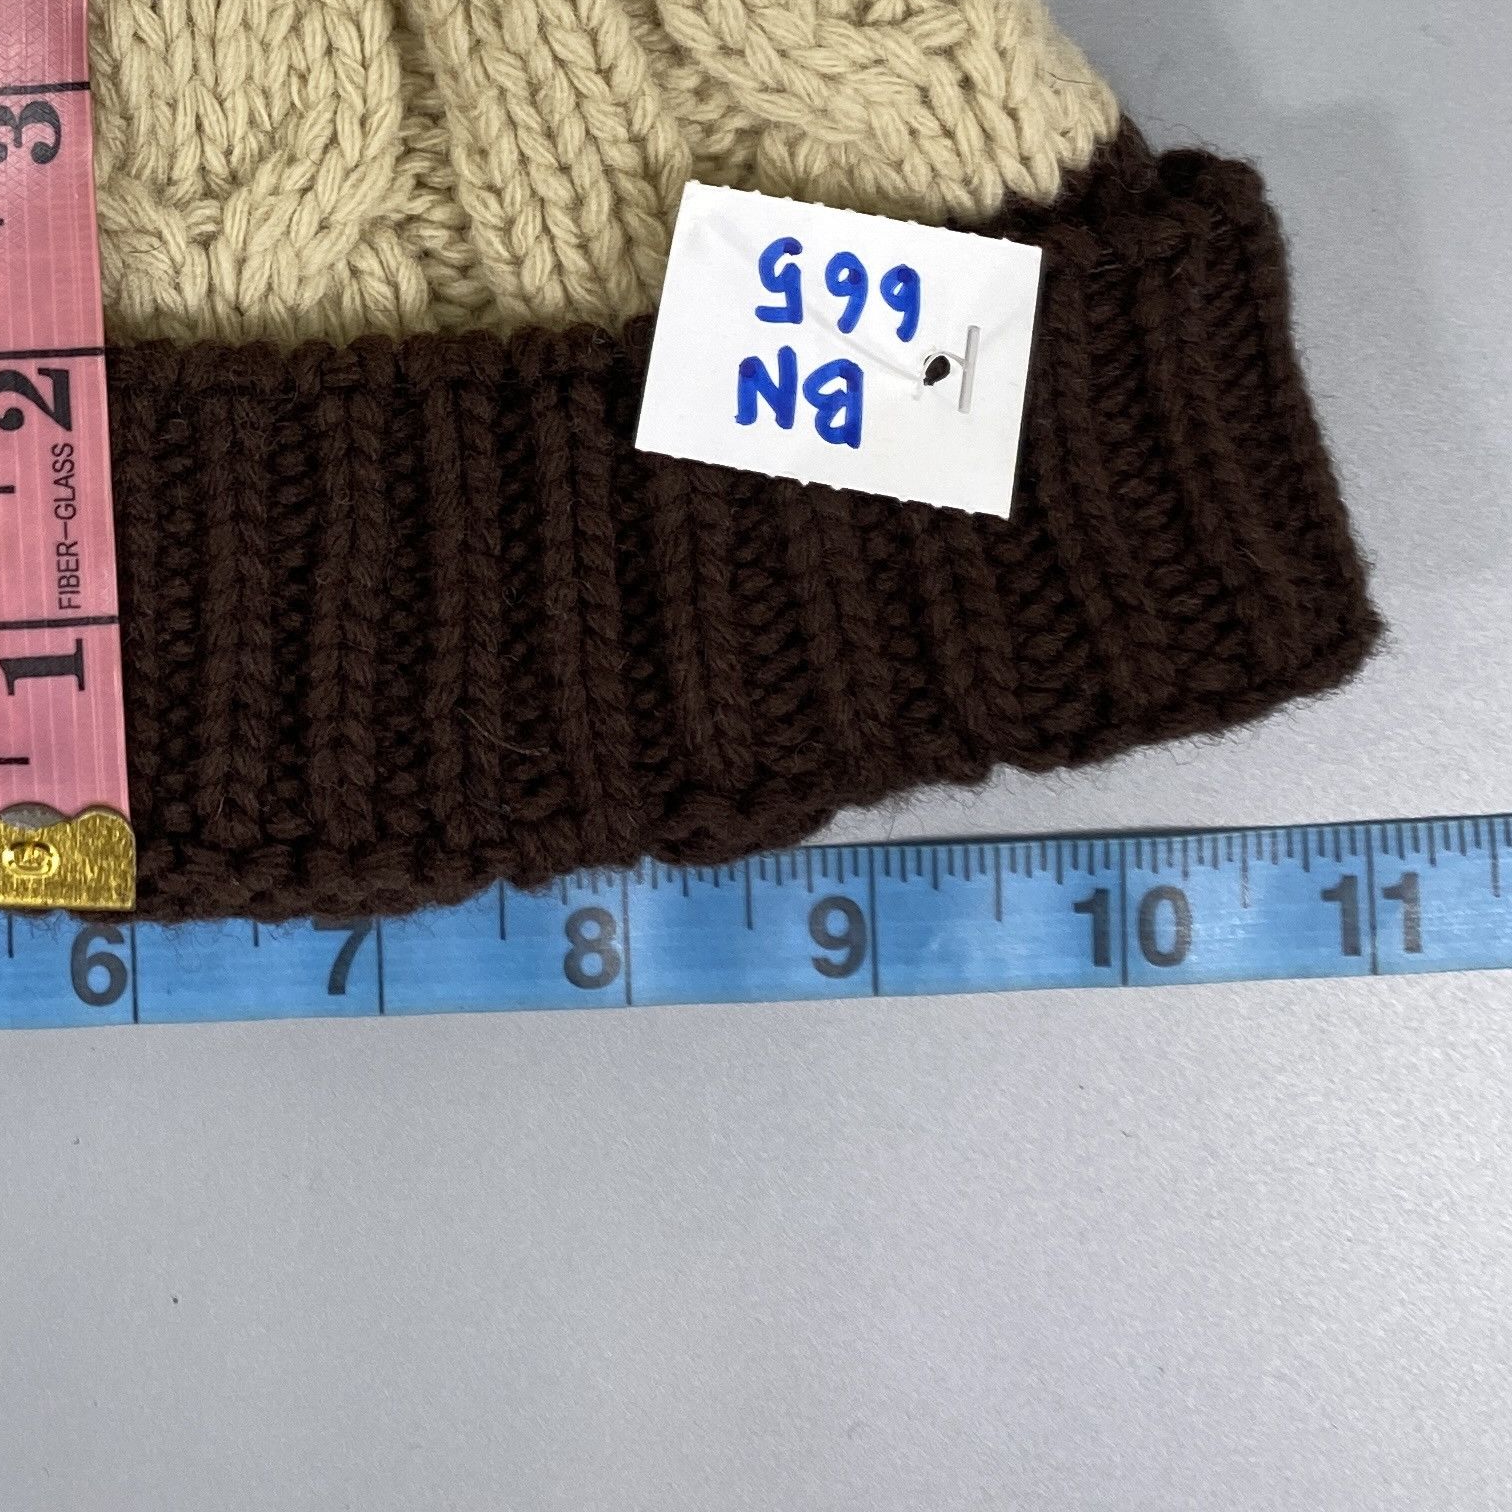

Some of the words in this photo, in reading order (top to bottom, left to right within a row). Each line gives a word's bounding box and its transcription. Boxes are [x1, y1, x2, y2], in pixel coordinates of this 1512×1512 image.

[754, 236, 921, 343] 665
[734, 345, 865, 450] BN
[562, 906, 622, 990] 8
[807, 895, 868, 979] 9
[1072, 884, 1193, 968] 10
[1320, 872, 1423, 957] 11
[70, 924, 129, 1007] 6
[311, 918, 374, 996] 7
